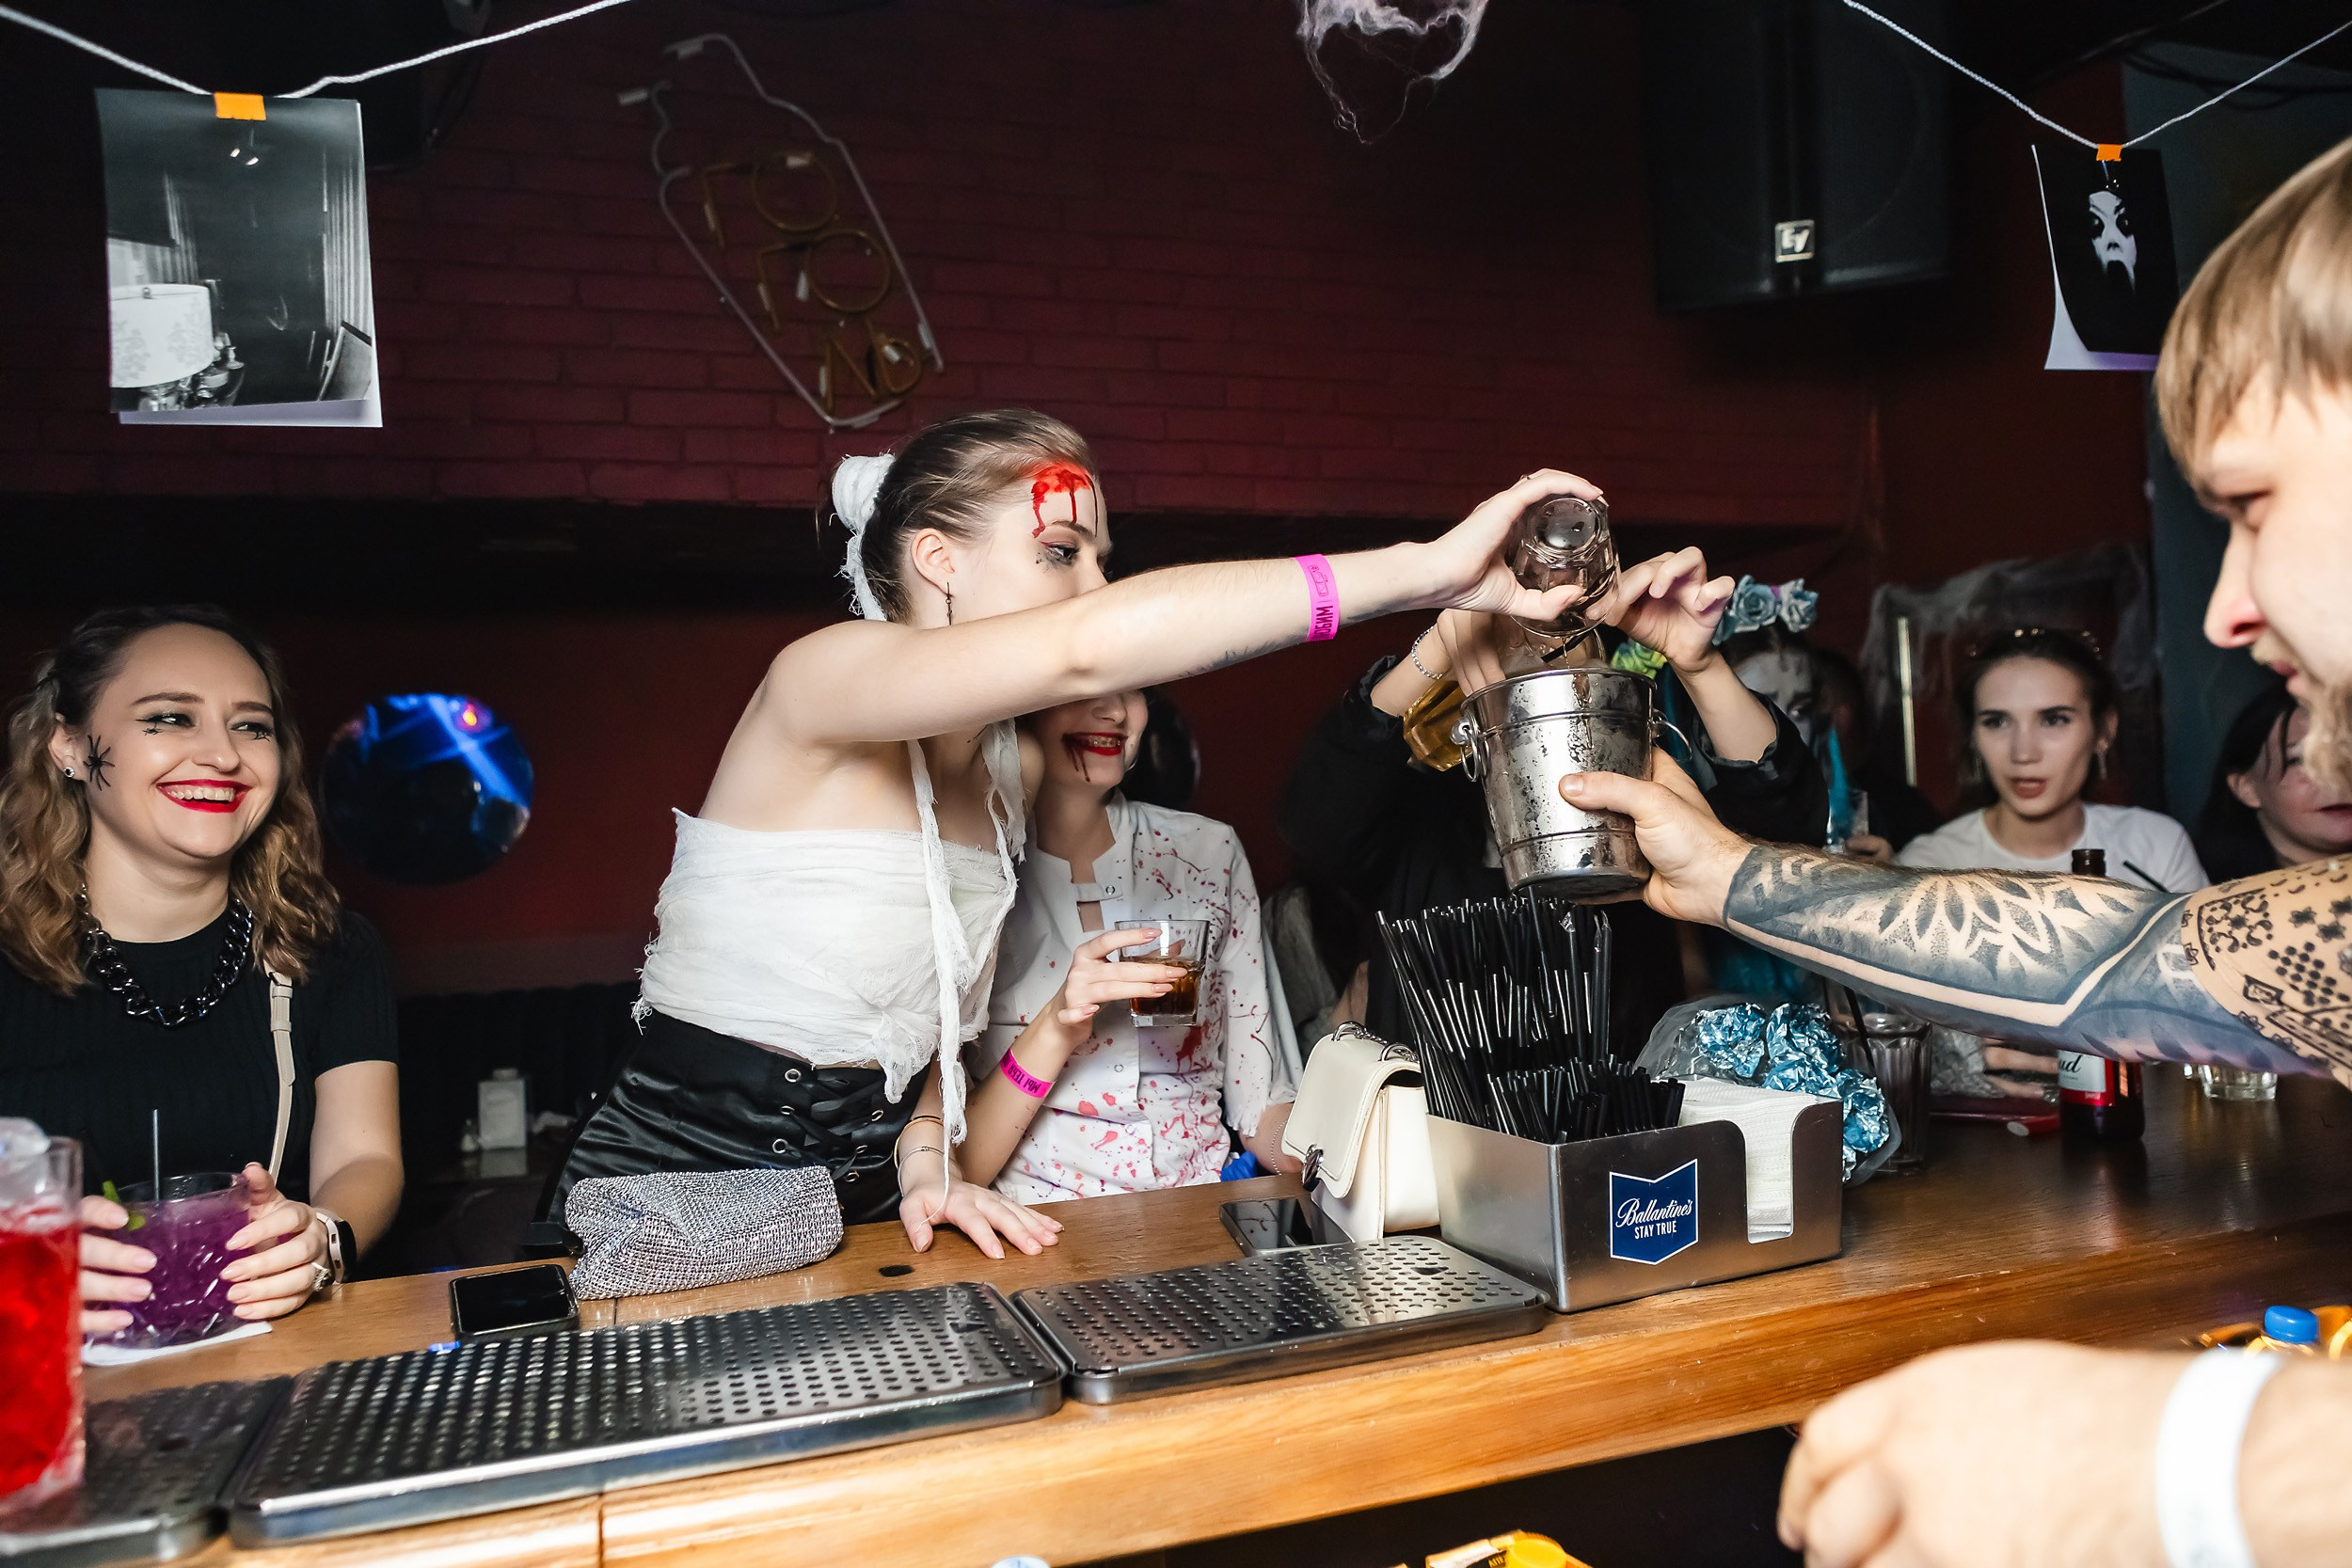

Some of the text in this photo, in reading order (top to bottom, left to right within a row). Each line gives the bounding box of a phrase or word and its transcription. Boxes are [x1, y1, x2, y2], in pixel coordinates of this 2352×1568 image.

[1781, 228, 1810, 253] EV
[2058, 1054, 2082, 1073] ud
[1023, 1078, 1041, 1093] МЫ
[1615, 1197, 1693, 1227] Ballantine's
[1634, 1220, 1677, 1240] STAY TRUE
